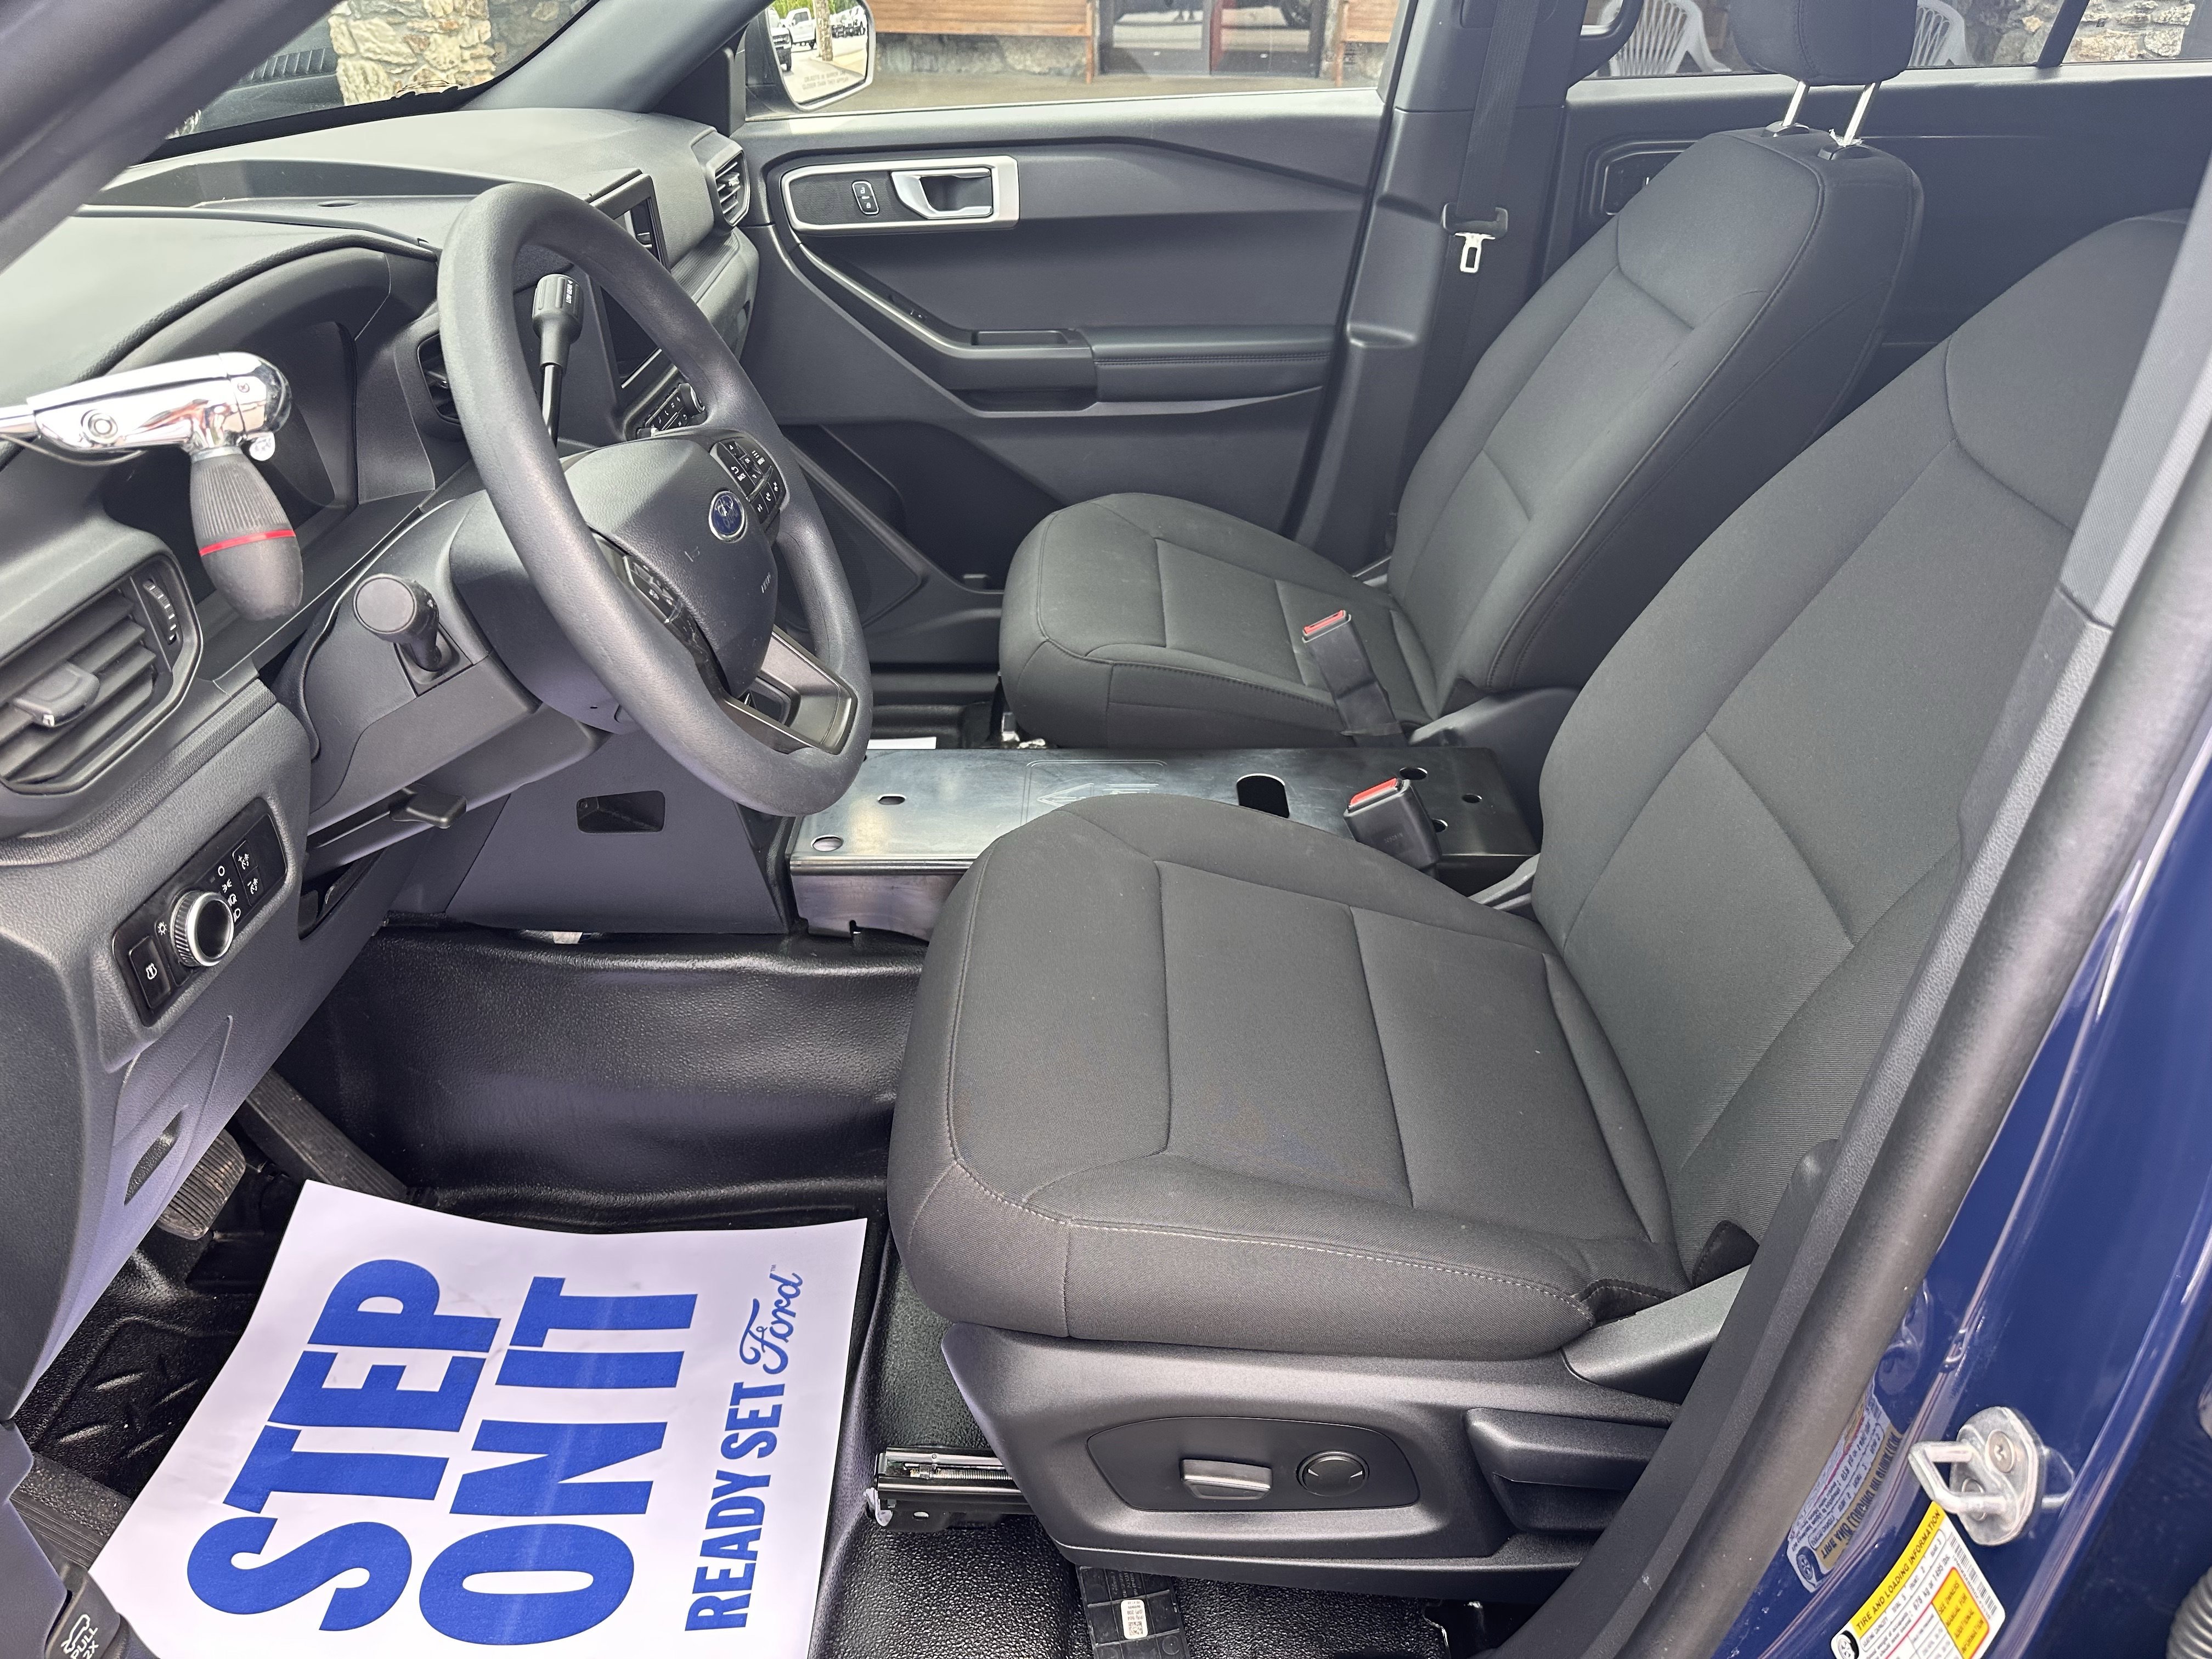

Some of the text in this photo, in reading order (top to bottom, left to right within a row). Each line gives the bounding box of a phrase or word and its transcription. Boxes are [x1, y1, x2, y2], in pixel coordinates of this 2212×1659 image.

[739, 1272, 803, 1374] Ford
[187, 1259, 500, 1631] STEP
[419, 1276, 698, 1645] ON IT
[721, 1382, 784, 1460] SET
[685, 1470, 771, 1631] READY
[1856, 1611, 1872, 1630] TIRE
[1873, 1596, 1884, 1614] AND
[1884, 1563, 1909, 1598] LOADING
[1908, 1509, 1941, 1564] INFORMATION
[70, 1627, 99, 1659] PULL
[82, 1640, 99, 1659] 2X
